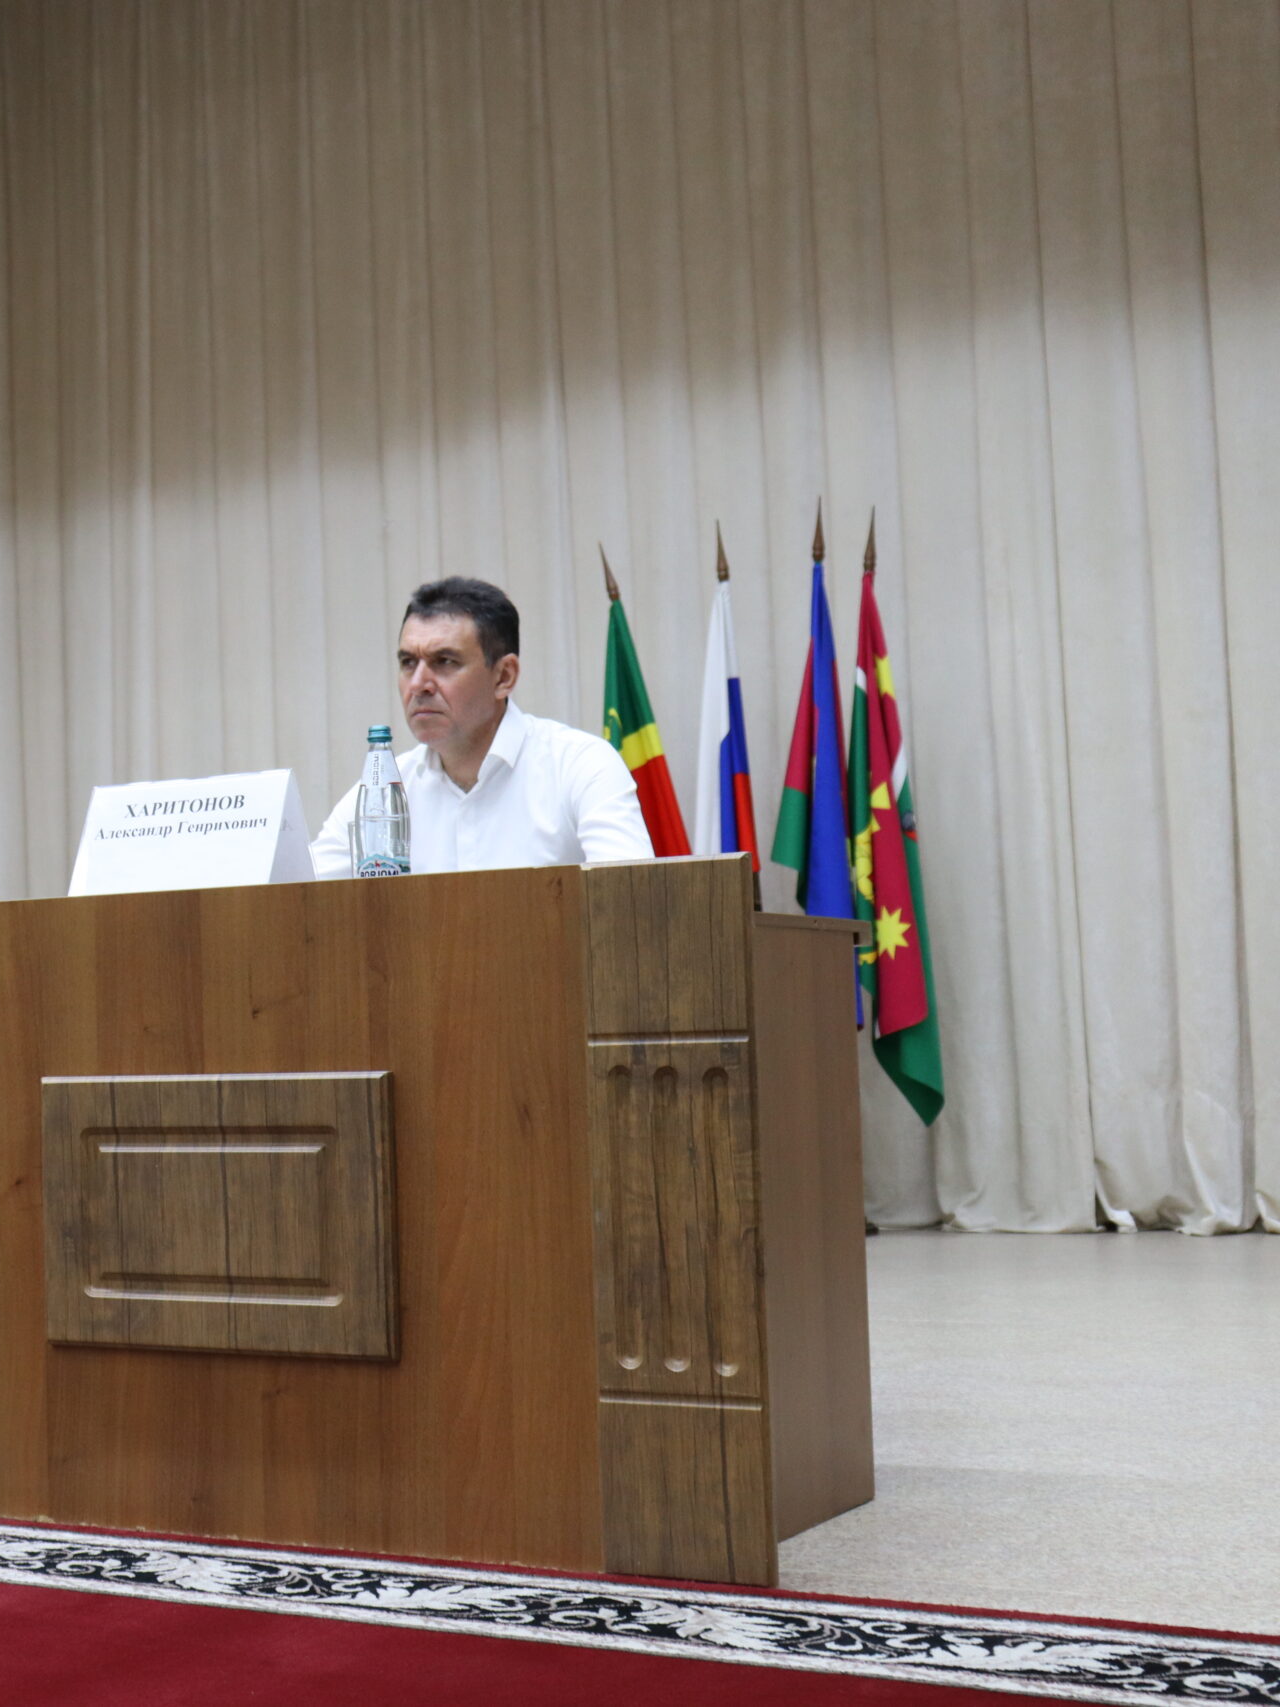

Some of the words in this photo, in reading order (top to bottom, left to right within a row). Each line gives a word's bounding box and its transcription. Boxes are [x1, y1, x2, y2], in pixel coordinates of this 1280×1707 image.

[124, 794, 245, 818] ХАРИТОНОВ
[94, 824, 173, 841] Александр
[177, 817, 268, 836] Генрихович
